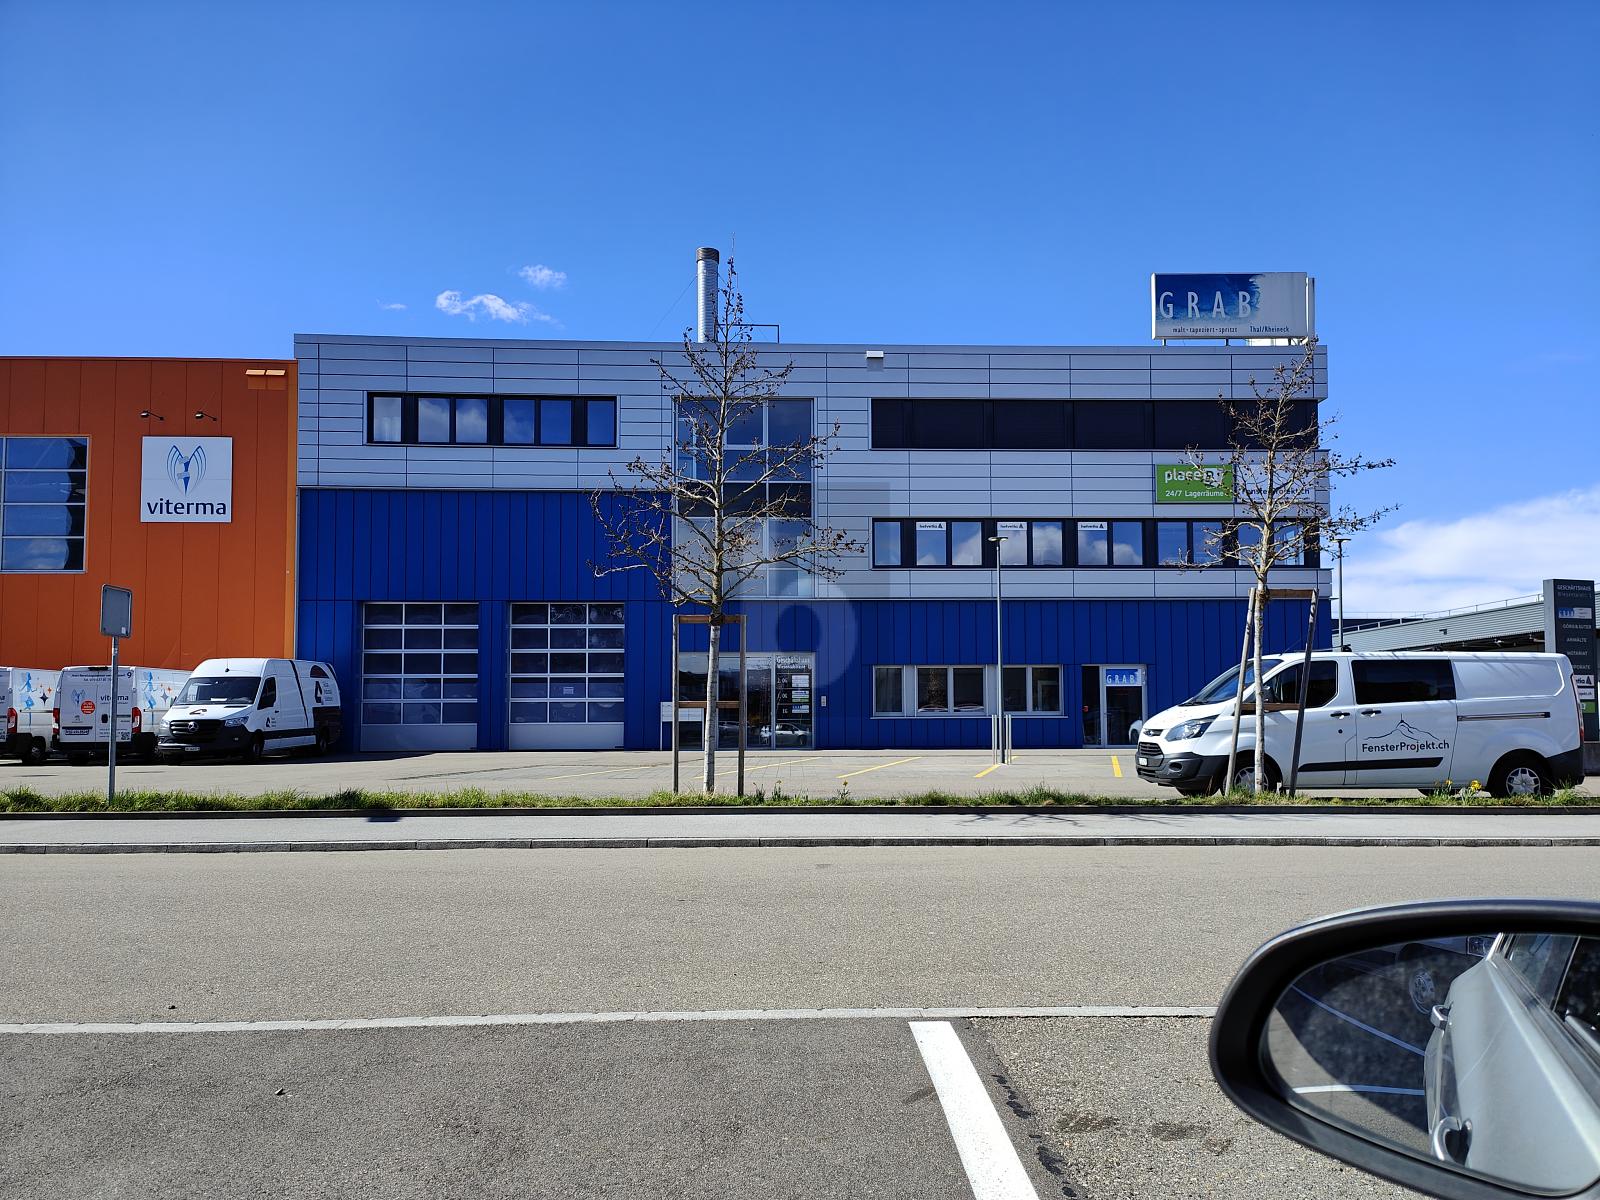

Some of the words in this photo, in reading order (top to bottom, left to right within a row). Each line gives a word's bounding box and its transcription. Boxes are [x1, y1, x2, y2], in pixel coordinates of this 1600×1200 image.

[1159, 291, 1251, 318] GRAB
[1184, 490, 1224, 498] Lagerräume
[146, 497, 227, 515] viterma
[126, 671, 132, 679] 9
[1106, 674, 1136, 684] GRAB
[1362, 739, 1450, 752] FensterProjekt.ch
